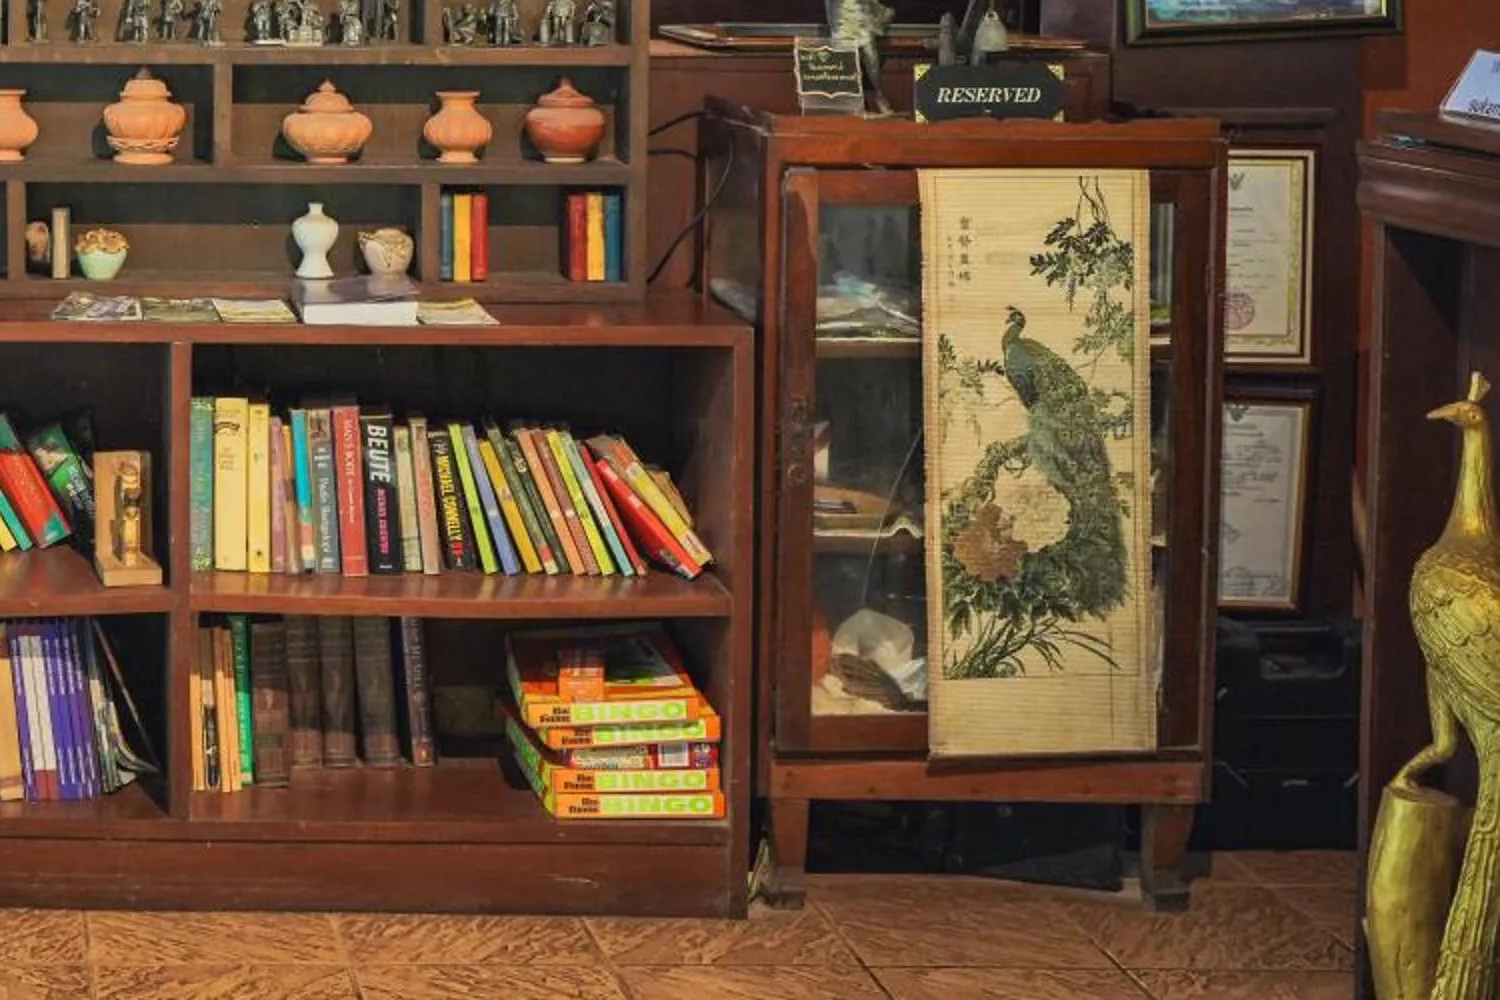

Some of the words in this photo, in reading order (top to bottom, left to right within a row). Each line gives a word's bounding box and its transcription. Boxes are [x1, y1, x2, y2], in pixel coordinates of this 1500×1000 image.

[936, 87, 1041, 104] RESERVED
[367, 424, 391, 483] BEUTE
[573, 702, 685, 722] BINGO
[599, 772, 704, 789] BINGO
[603, 797, 711, 813] BINGO
